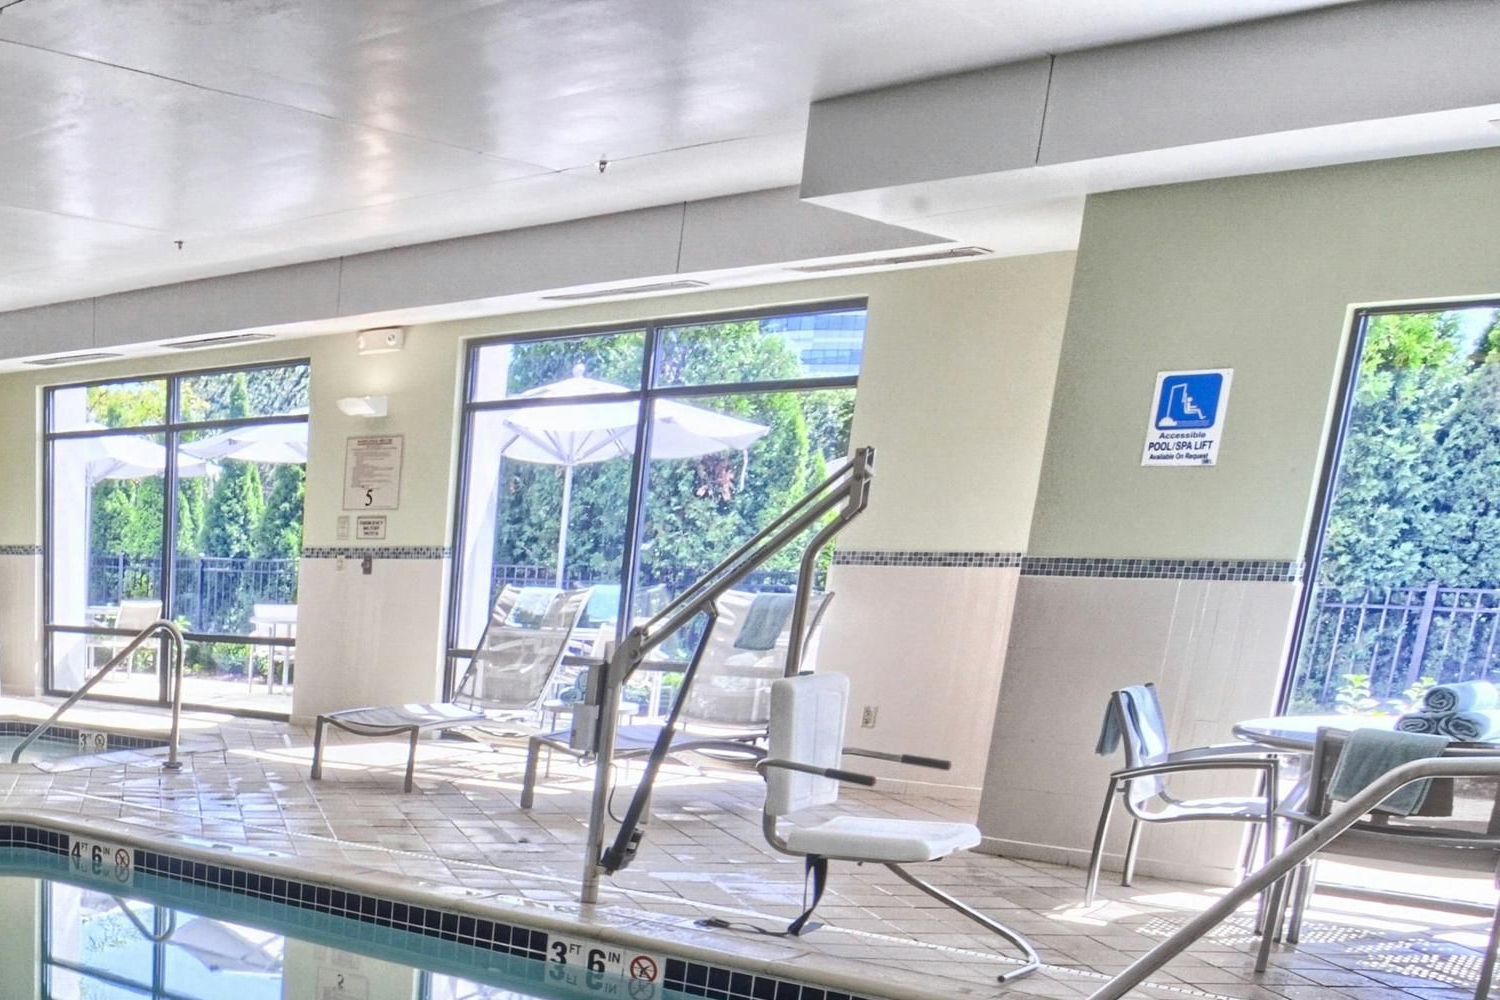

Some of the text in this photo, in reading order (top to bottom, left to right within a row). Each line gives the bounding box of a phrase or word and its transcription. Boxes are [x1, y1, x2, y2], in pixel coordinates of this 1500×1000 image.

[1159, 431, 1207, 439] Accessible
[1148, 440, 1214, 451] POOL/SPA LIFT
[364, 489, 373, 506] 5
[71, 841, 110, 863] 4 FT 6 IN
[550, 941, 621, 973] 3 FT 6 IN
